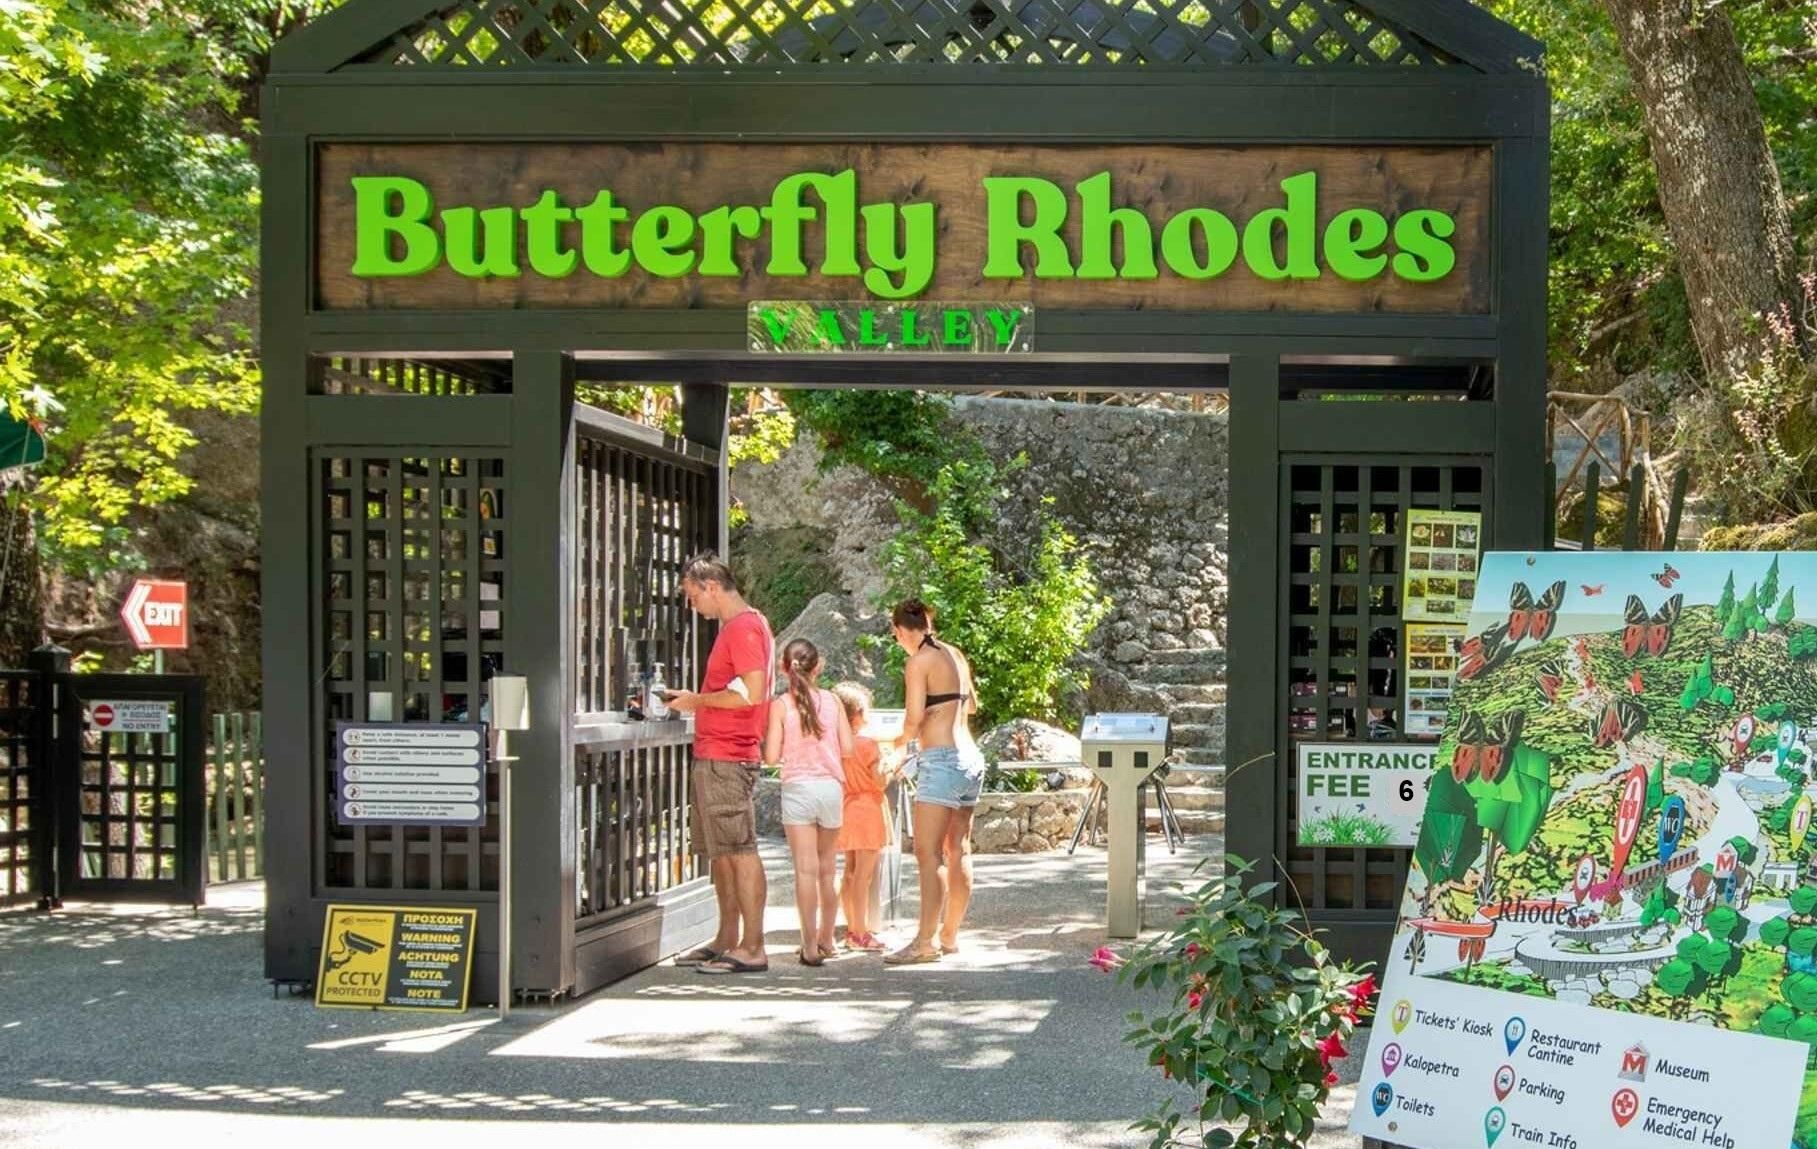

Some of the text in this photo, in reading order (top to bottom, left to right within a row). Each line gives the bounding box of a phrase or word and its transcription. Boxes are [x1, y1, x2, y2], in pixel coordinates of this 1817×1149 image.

[351, 168, 1457, 299] Butterfly Rhodes
[758, 308, 1021, 345] VALLEY
[143, 601, 183, 627] EXIT
[1306, 774, 1371, 797] FEE
[1399, 779, 1414, 801] 6
[403, 913, 465, 925] ΠΡΟΣΟΧΗ
[1498, 893, 1578, 926] Rhodes
[401, 932, 461, 944] WARNING
[398, 951, 459, 963] ACHTUNG
[338, 970, 383, 987] CCTV
[410, 969, 443, 979] NOTA
[326, 986, 381, 998] PROTECTED
[407, 988, 441, 999] NOTE
[1462, 1018, 1494, 1037] Kiosk
[1531, 1028, 1602, 1056] Restaurant
[1404, 1053, 1460, 1078] Kalopetra
[1527, 1046, 1575, 1067] Cantine
[1655, 1058, 1710, 1083] Museum
[1519, 1078, 1566, 1105] Parking
[1396, 1095, 1436, 1117] Toilets
[1647, 1097, 1723, 1130] Emergency
[1511, 1122, 1578, 1149] Train Info
[1643, 1117, 1697, 1142] Medical
[1702, 1128, 1736, 1149] Help
